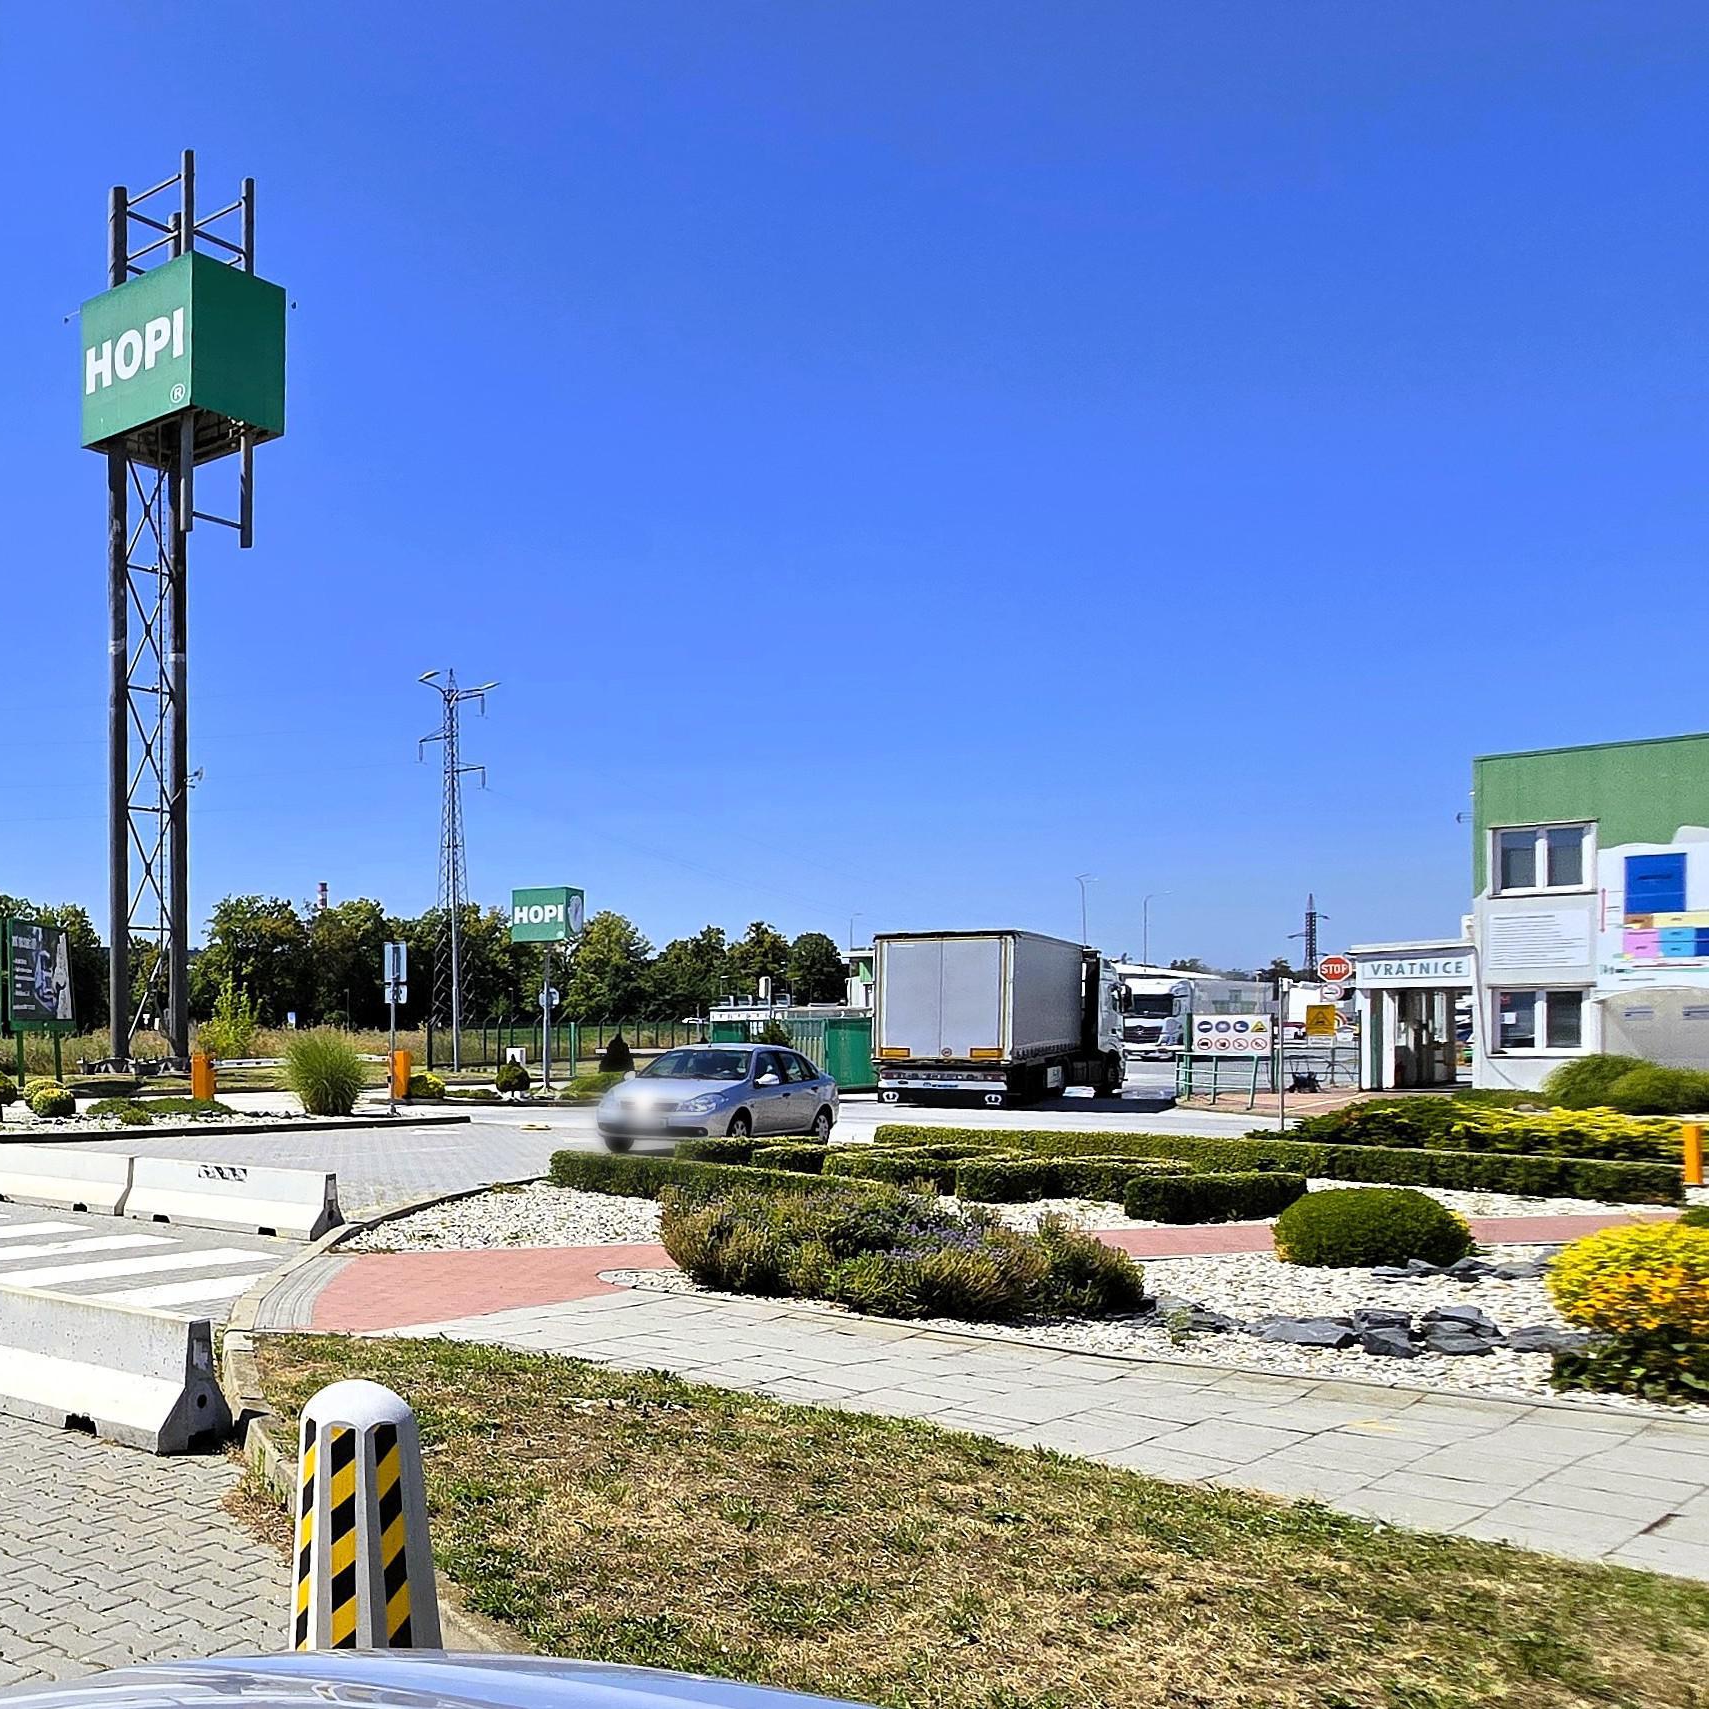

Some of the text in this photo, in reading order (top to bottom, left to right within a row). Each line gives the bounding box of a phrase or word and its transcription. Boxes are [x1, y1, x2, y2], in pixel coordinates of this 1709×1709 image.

[85, 307, 184, 395] HOPI
[514, 904, 564, 924] HOPI
[1321, 963, 1348, 975] STOP
[1371, 961, 1463, 975] VRATNICE
